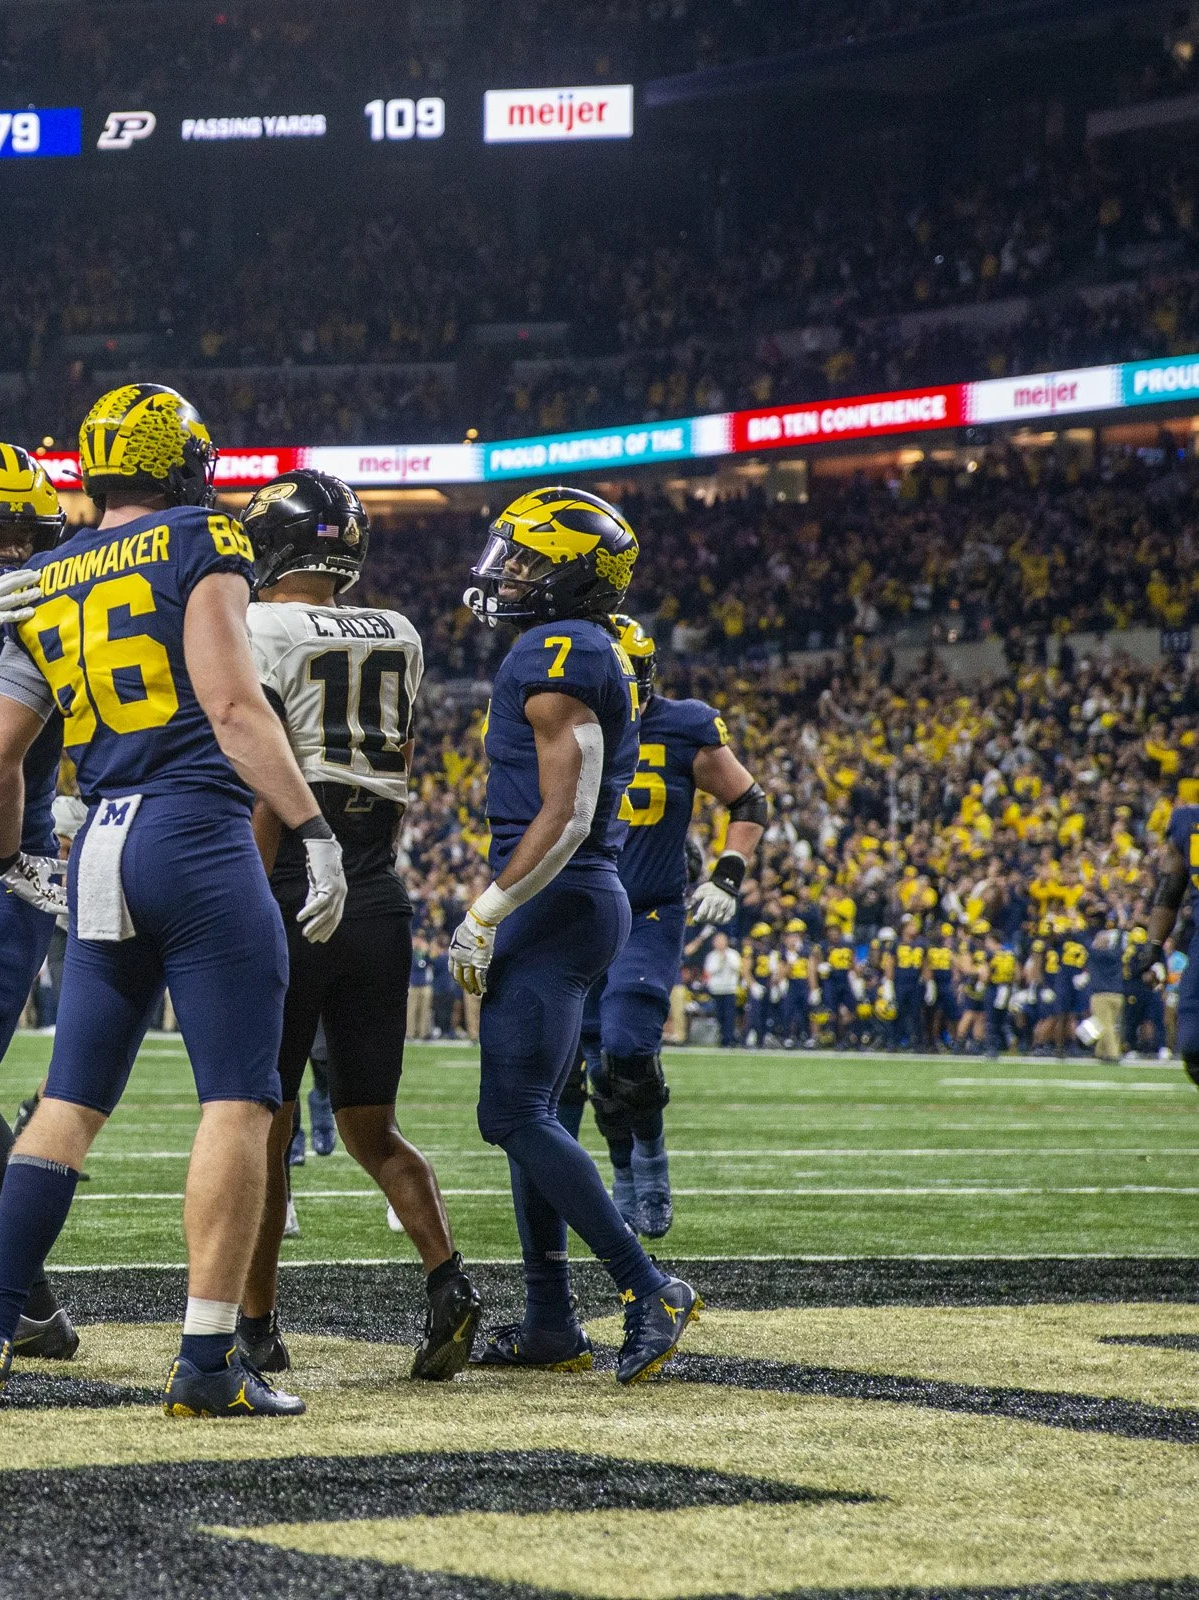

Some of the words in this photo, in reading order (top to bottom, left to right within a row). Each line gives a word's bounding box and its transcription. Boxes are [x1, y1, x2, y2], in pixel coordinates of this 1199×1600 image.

[181, 117, 261, 140] PASSING
[263, 113, 327, 137] YARDS
[364, 97, 447, 141] 109
[507, 93, 610, 132] meijer
[1012, 378, 1079, 413] meijer
[747, 415, 782, 443] BIG
[783, 411, 820, 437] TEN
[820, 394, 948, 433] CONFERENCE
[358, 452, 432, 482] meijer
[491, 446, 546, 468] PROUD
[547, 438, 618, 464] PARTNER
[619, 433, 644, 454] OF
[645, 427, 683, 452] THE
[207, 514, 256, 563] 86
[308, 613, 334, 637] C.
[335, 615, 395, 639] ALLEN
[16, 573, 179, 747] 86
[543, 636, 572, 678] 7
[306, 648, 410, 770] 10
[100, 802, 130, 826] M
